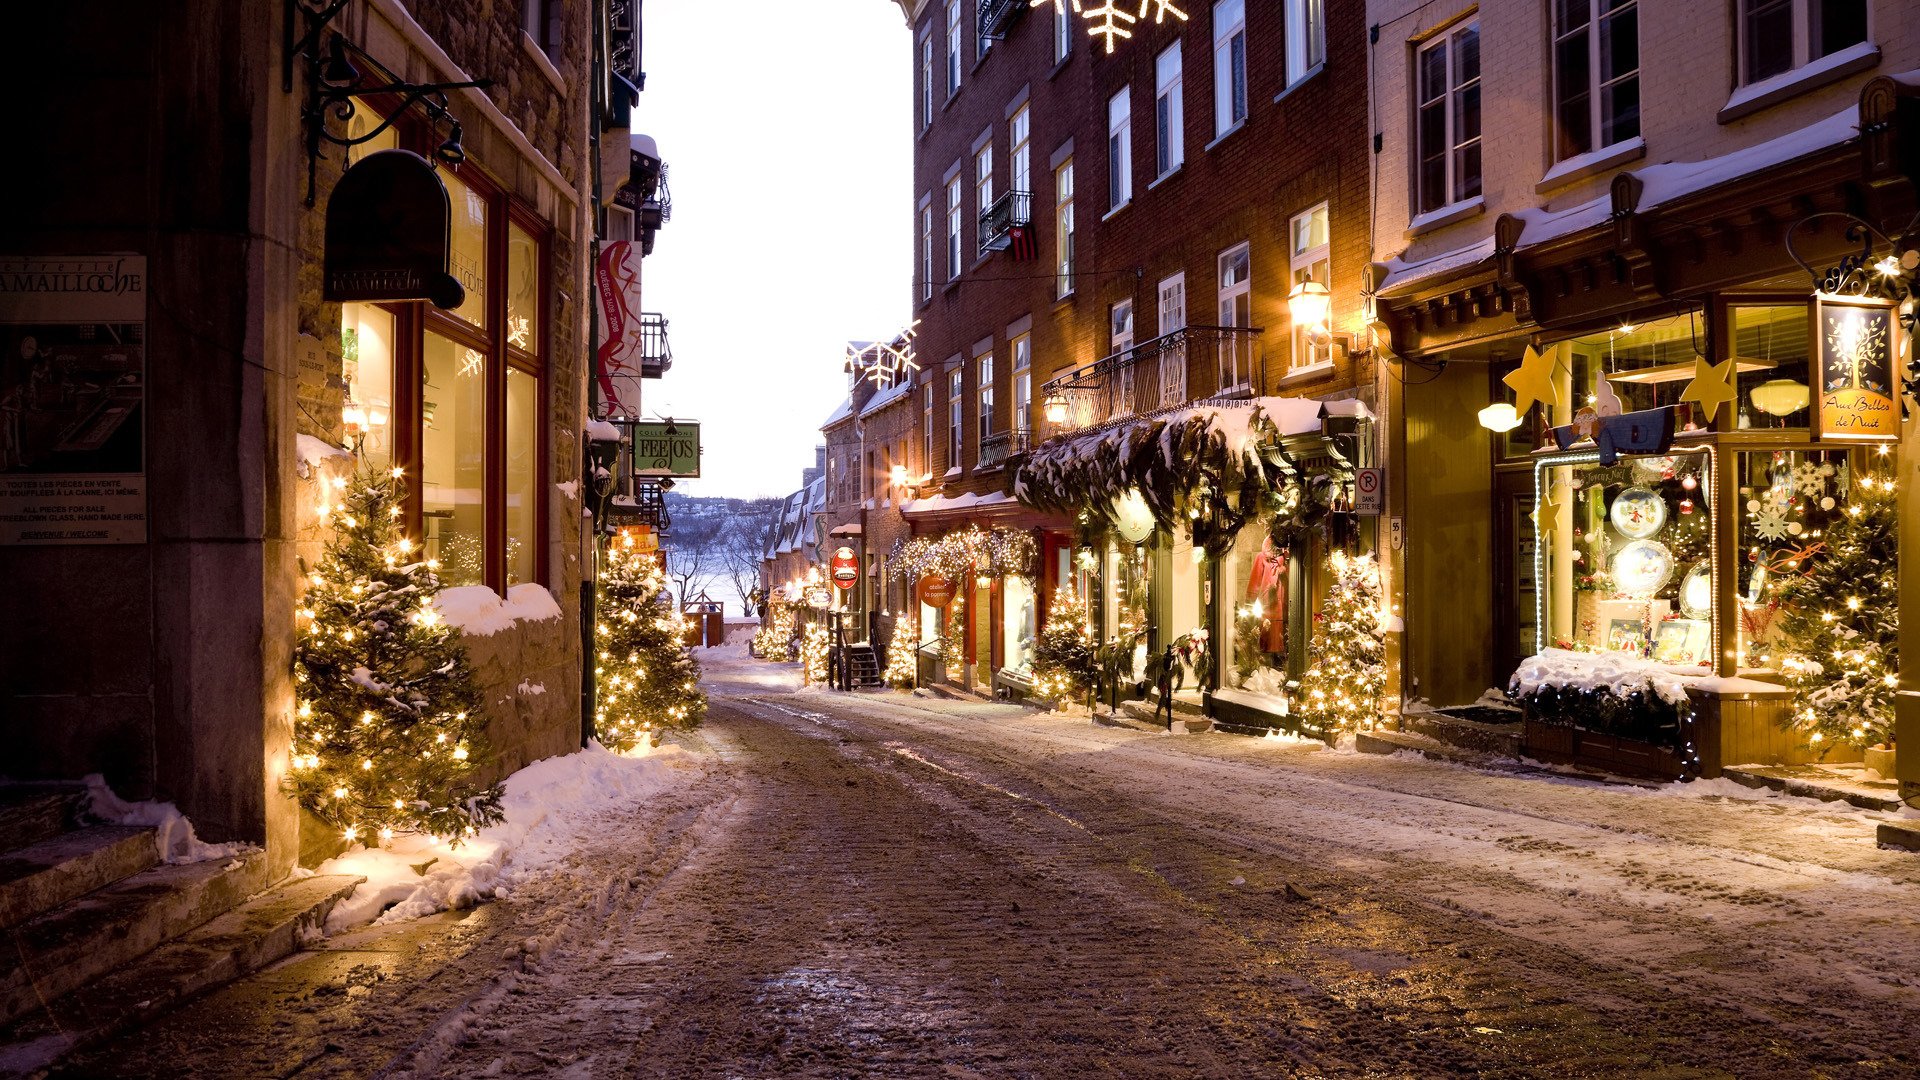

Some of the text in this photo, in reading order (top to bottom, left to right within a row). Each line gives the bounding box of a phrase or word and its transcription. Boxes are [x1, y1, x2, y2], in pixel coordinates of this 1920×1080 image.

[1823, 395, 1890, 412] Aux Belles
[1835, 413, 1879, 428] de Nuit
[55, 480, 83, 488] PIÈCES
[96, 480, 121, 488] VENTE
[1392, 523, 1399, 531] 55
